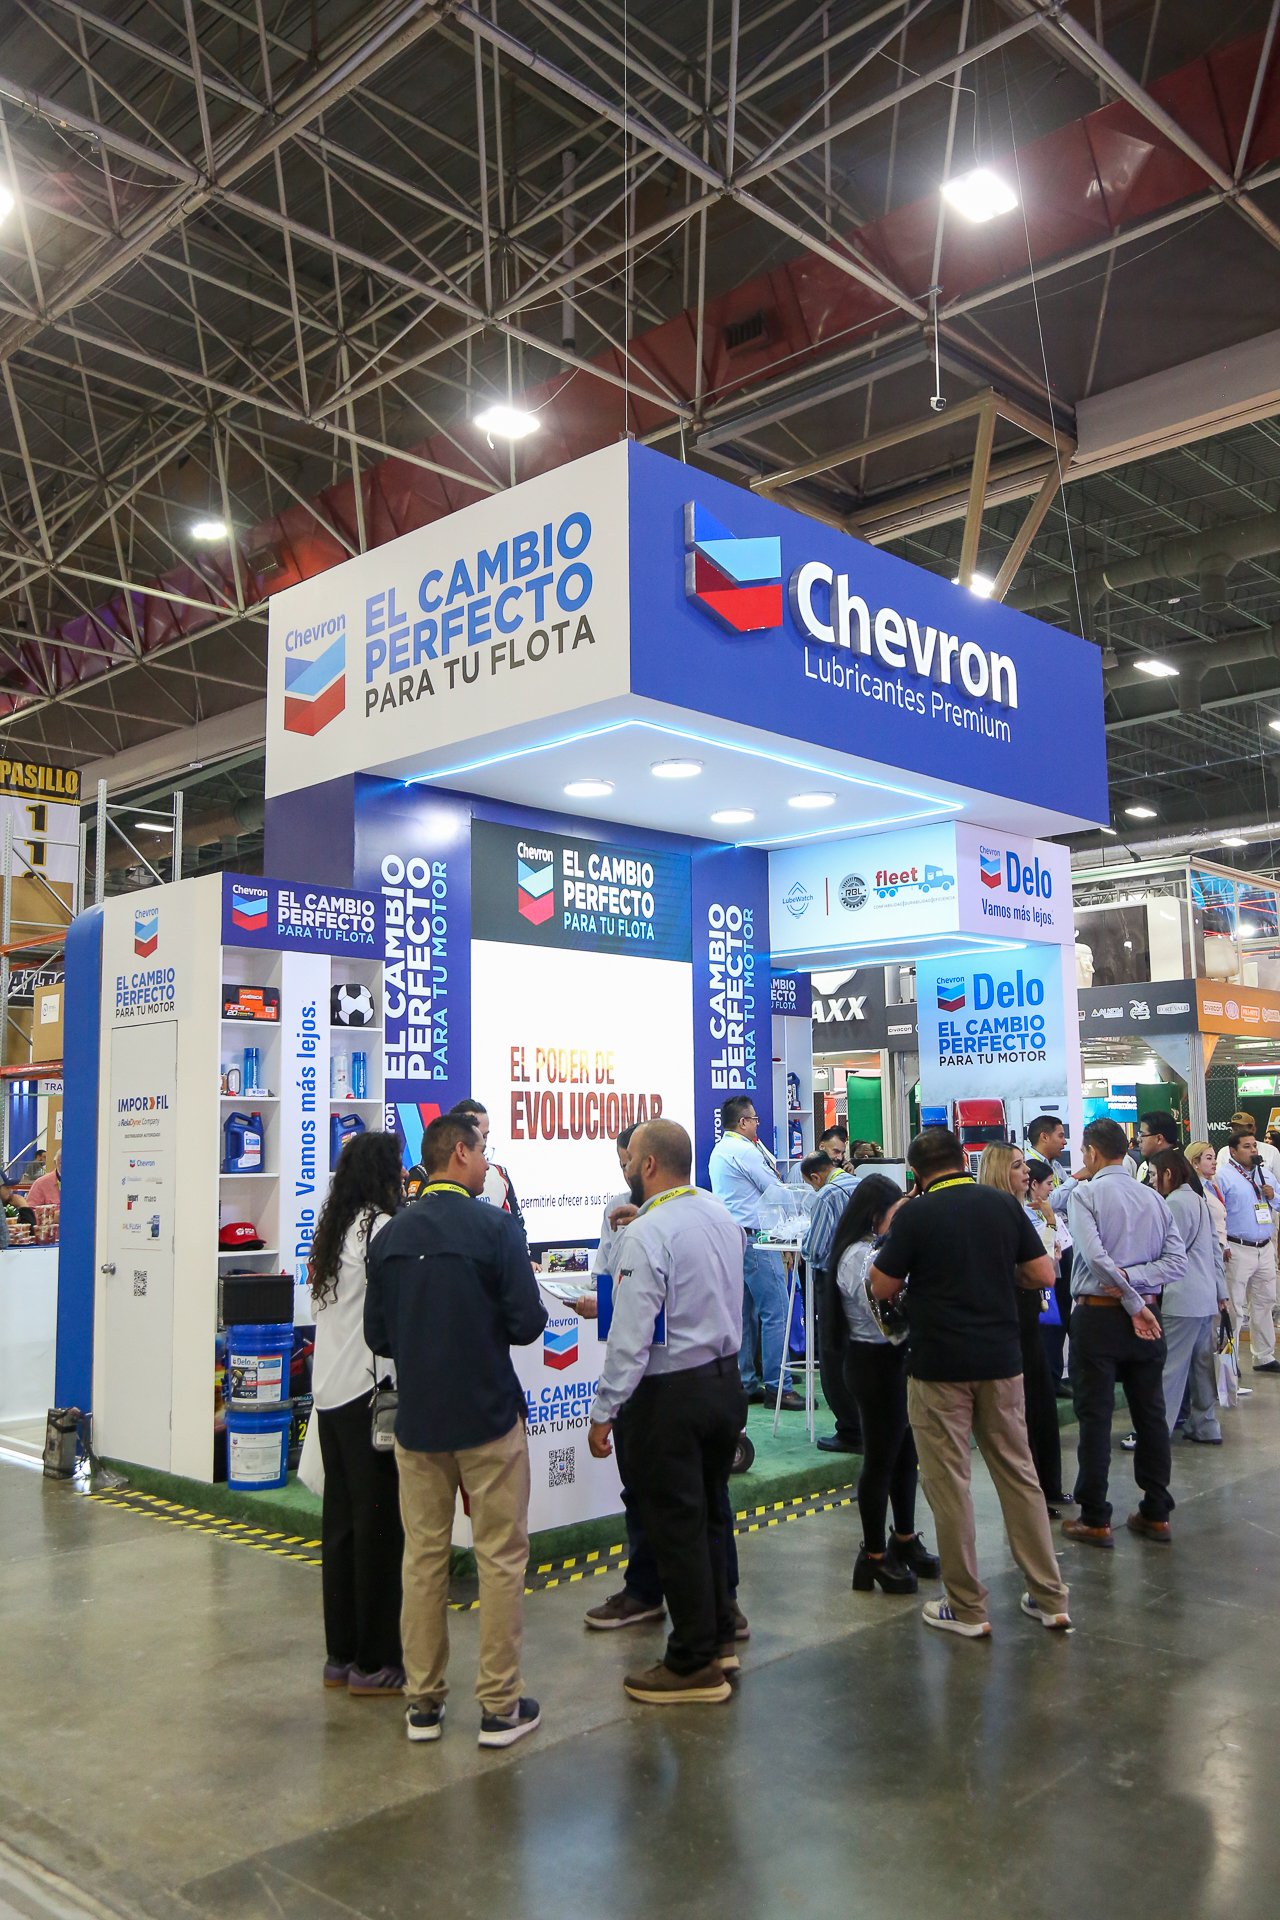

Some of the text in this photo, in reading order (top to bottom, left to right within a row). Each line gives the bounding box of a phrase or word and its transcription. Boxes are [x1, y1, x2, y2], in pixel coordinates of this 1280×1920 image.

[366, 512, 592, 637] EL CAMBIO
[285, 613, 346, 652] Chevron
[366, 562, 593, 684] PERFECTO
[796, 561, 1018, 709] Chevron
[366, 615, 595, 717] PARA TU FLOTA
[804, 646, 1011, 743] Lubricantes Premium
[0, 760, 79, 795] PASILLO
[517, 842, 554, 862] Chevron
[980, 845, 1000, 857] Chevron
[563, 850, 654, 889] EL CAMBIO
[875, 867, 918, 887] fleet
[1006, 851, 1052, 899] Delo
[232, 884, 268, 897] Chevron
[278, 890, 375, 916] EL CAMBIO
[563, 880, 655, 919] PERFECTO
[782, 894, 814, 905] LubeWatch
[135, 908, 158, 919] Chevron
[278, 907, 375, 932] PERFECTO
[564, 912, 655, 940] PARA TU FLOTA
[982, 898, 1054, 927] Vamos más lejos.
[278, 925, 374, 944] PARA TU FLOTA
[381, 855, 406, 1019] CAMBIO
[117, 968, 175, 991] EL CAMBIO
[406, 857, 432, 1080] PERFECTO
[431, 862, 448, 1080] PARA TU MOTOR
[937, 977, 964, 985] Chevron
[116, 984, 175, 1007] PERFECTO
[708, 903, 728, 1090] EL CAMBIO
[726, 905, 746, 1090] PERFECTO
[770, 979, 796, 990] MBIO
[973, 969, 1044, 1010] Delo
[116, 1001, 175, 1018] PARA TU MOTOR
[742, 908, 757, 1090] PARA TU MOTOR
[938, 1015, 1045, 1037] EL CAMBIO
[385, 1031, 406, 1079] EL
[939, 1032, 1046, 1054] PERFECTO
[511, 1046, 615, 1084] EL PODER DE
[940, 1050, 1046, 1066] PARA TU MOTOR
[295, 1001, 320, 1257] Delo Vamos más lejos.
[520, 1194, 557, 1210] permitirle
[558, 1196, 583, 1207] ofrecer
[584, 1197, 589, 1206] a
[590, 1195, 601, 1206] sus
[528, 1398, 597, 1424] ERFECT
[550, 1421, 563, 1433] TU
